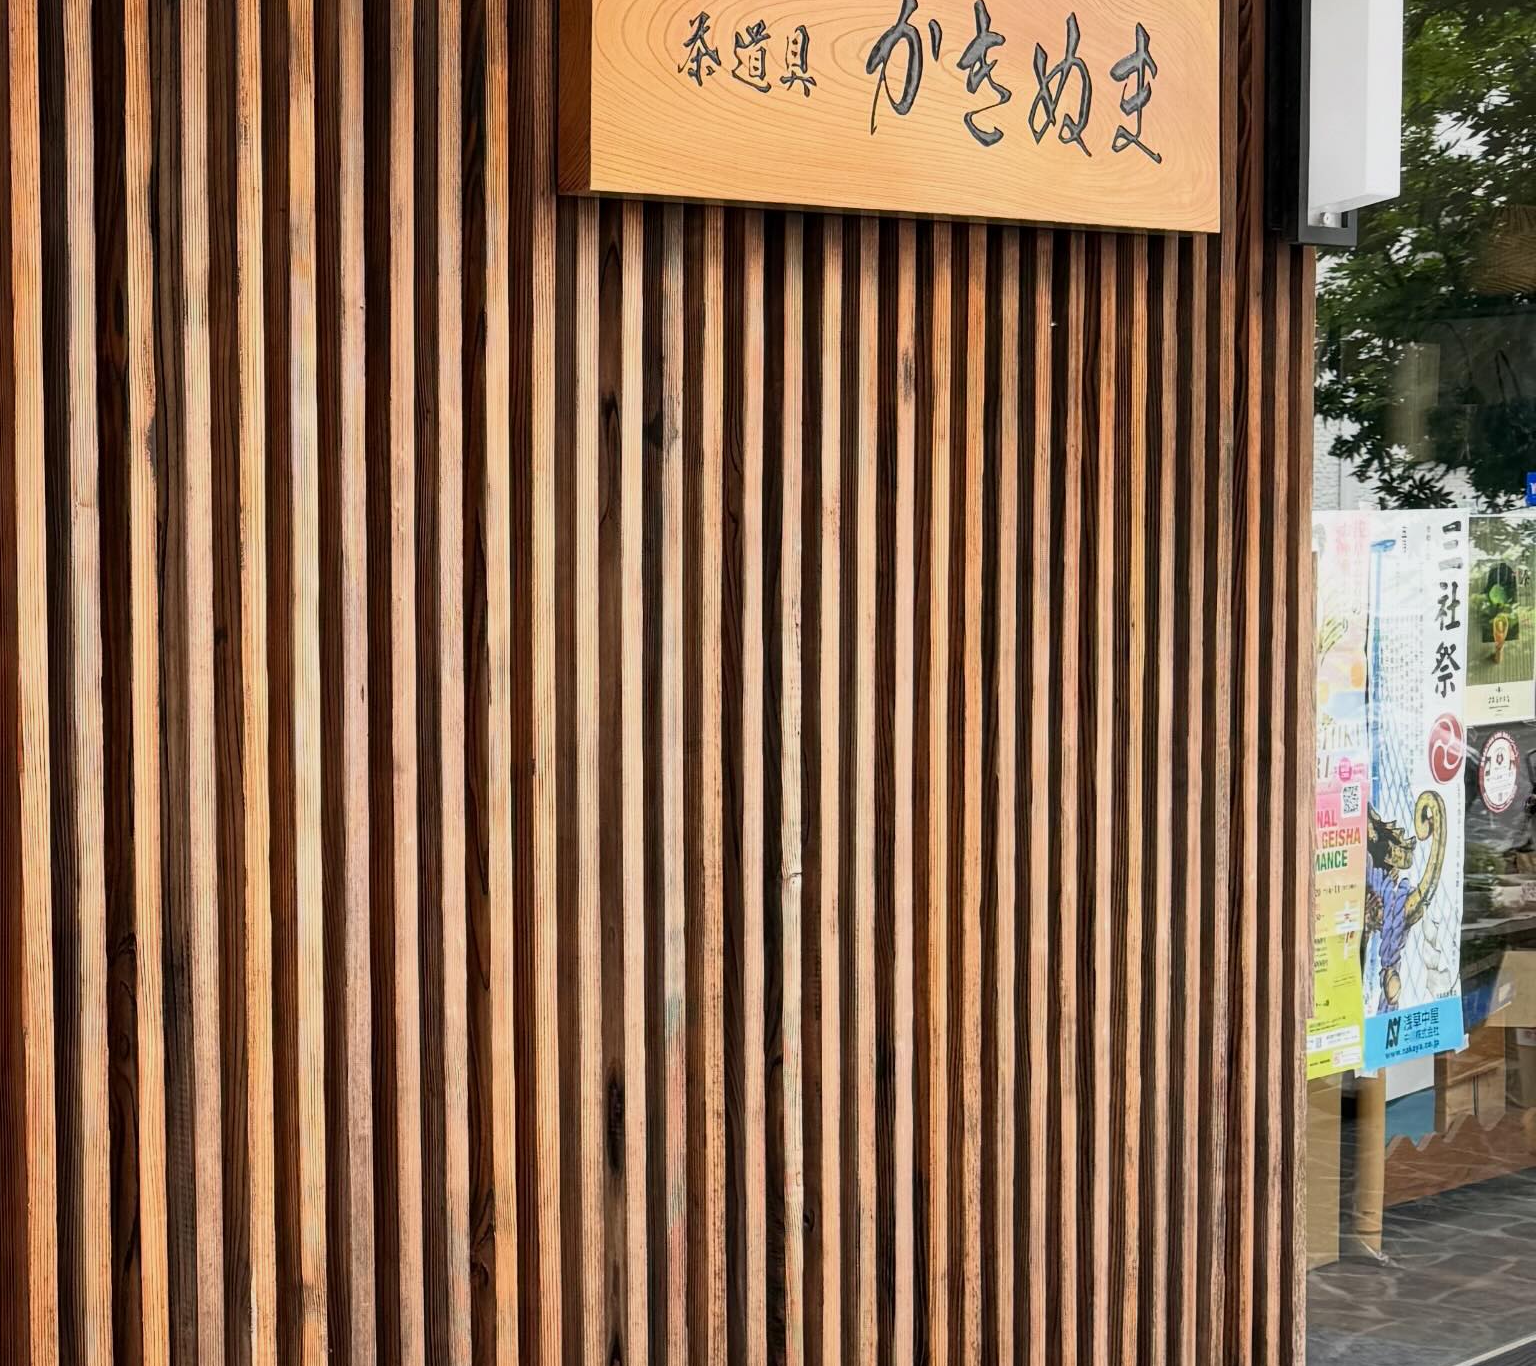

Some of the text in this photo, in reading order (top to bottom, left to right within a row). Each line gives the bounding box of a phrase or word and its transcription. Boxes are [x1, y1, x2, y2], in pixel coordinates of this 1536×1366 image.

[676, 11, 818, 99] 茶道具
[1431, 519, 1463, 700] 三社祭
[1322, 827, 1361, 849] GEISHA
[1403, 1007, 1439, 1032] 浅草中屋
